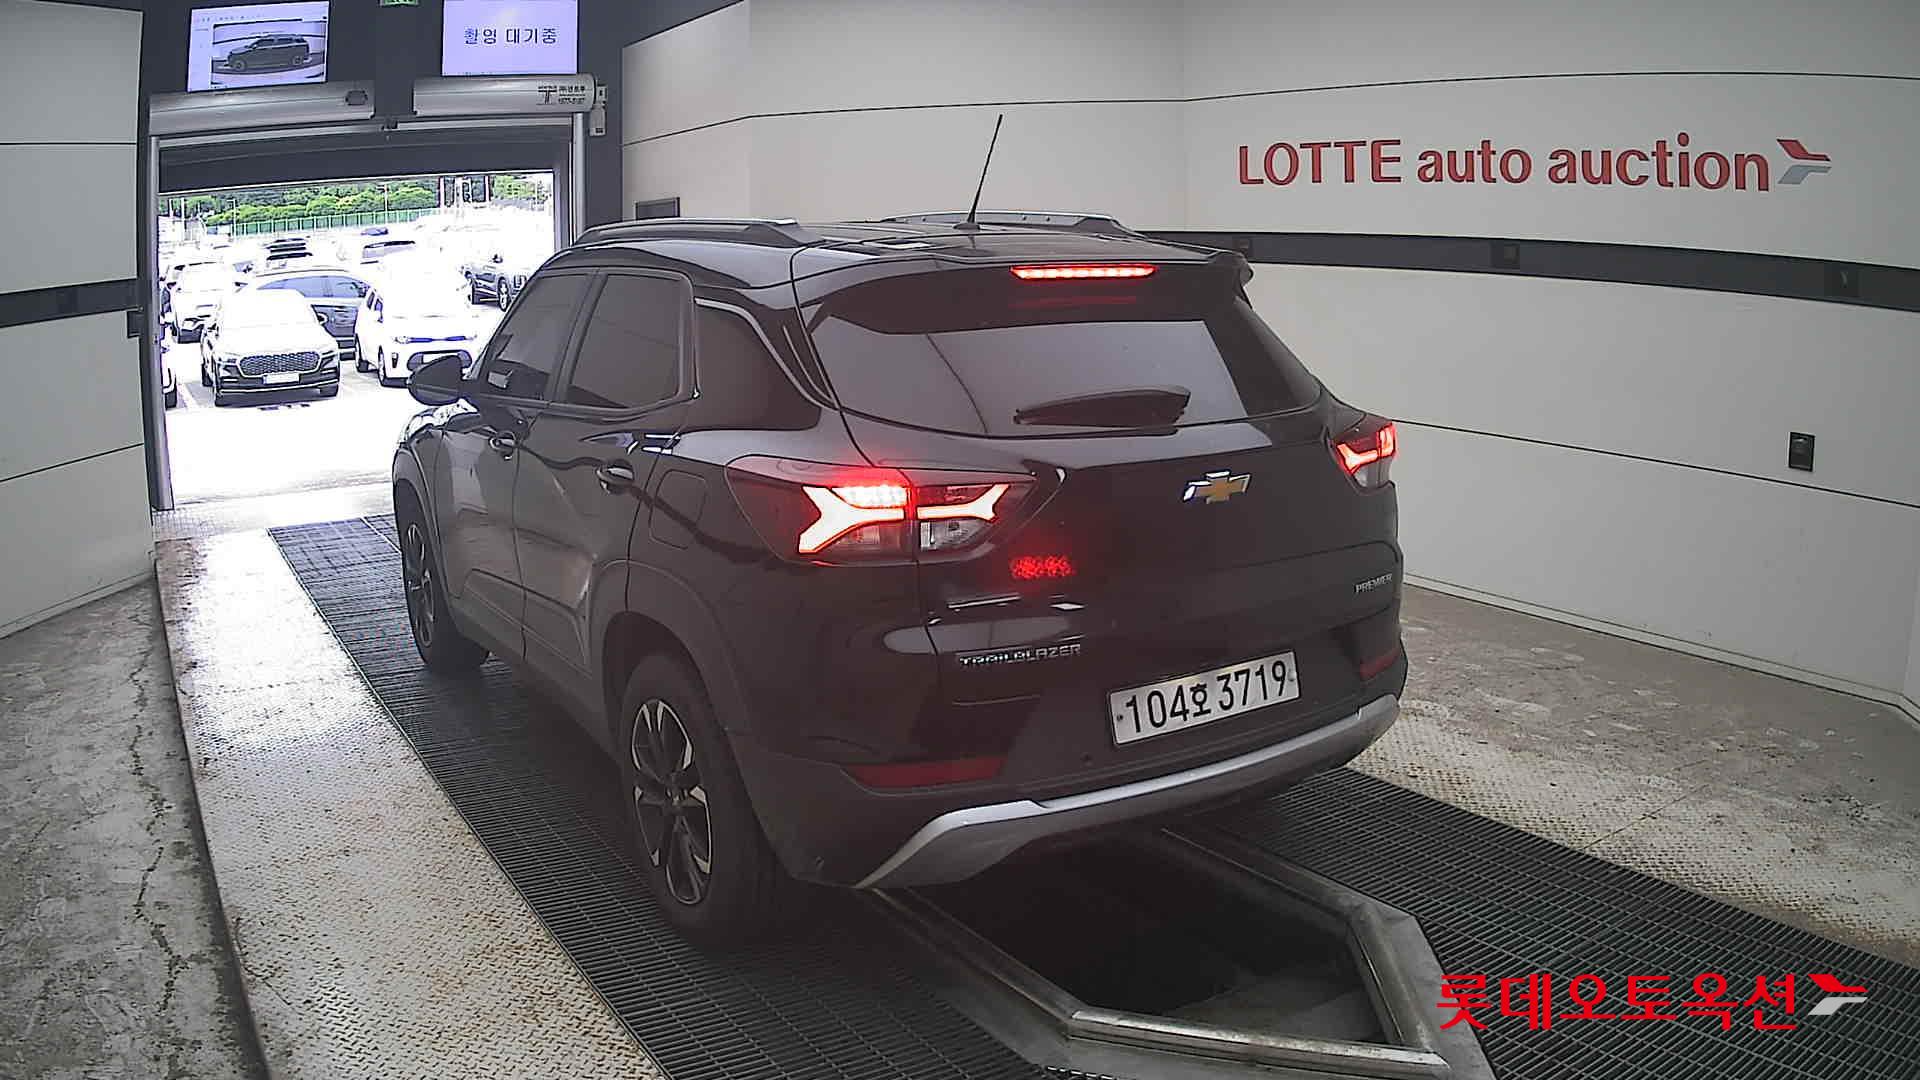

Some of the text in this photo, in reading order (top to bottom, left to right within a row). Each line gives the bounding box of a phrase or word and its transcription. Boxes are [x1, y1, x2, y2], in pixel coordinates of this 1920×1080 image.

[506, 28, 557, 44] 대기중
[1239, 132, 1770, 192] LOTTE auto auction
[1355, 573, 1393, 593] PREMIER
[959, 643, 1081, 666] TRAILBLAZER
